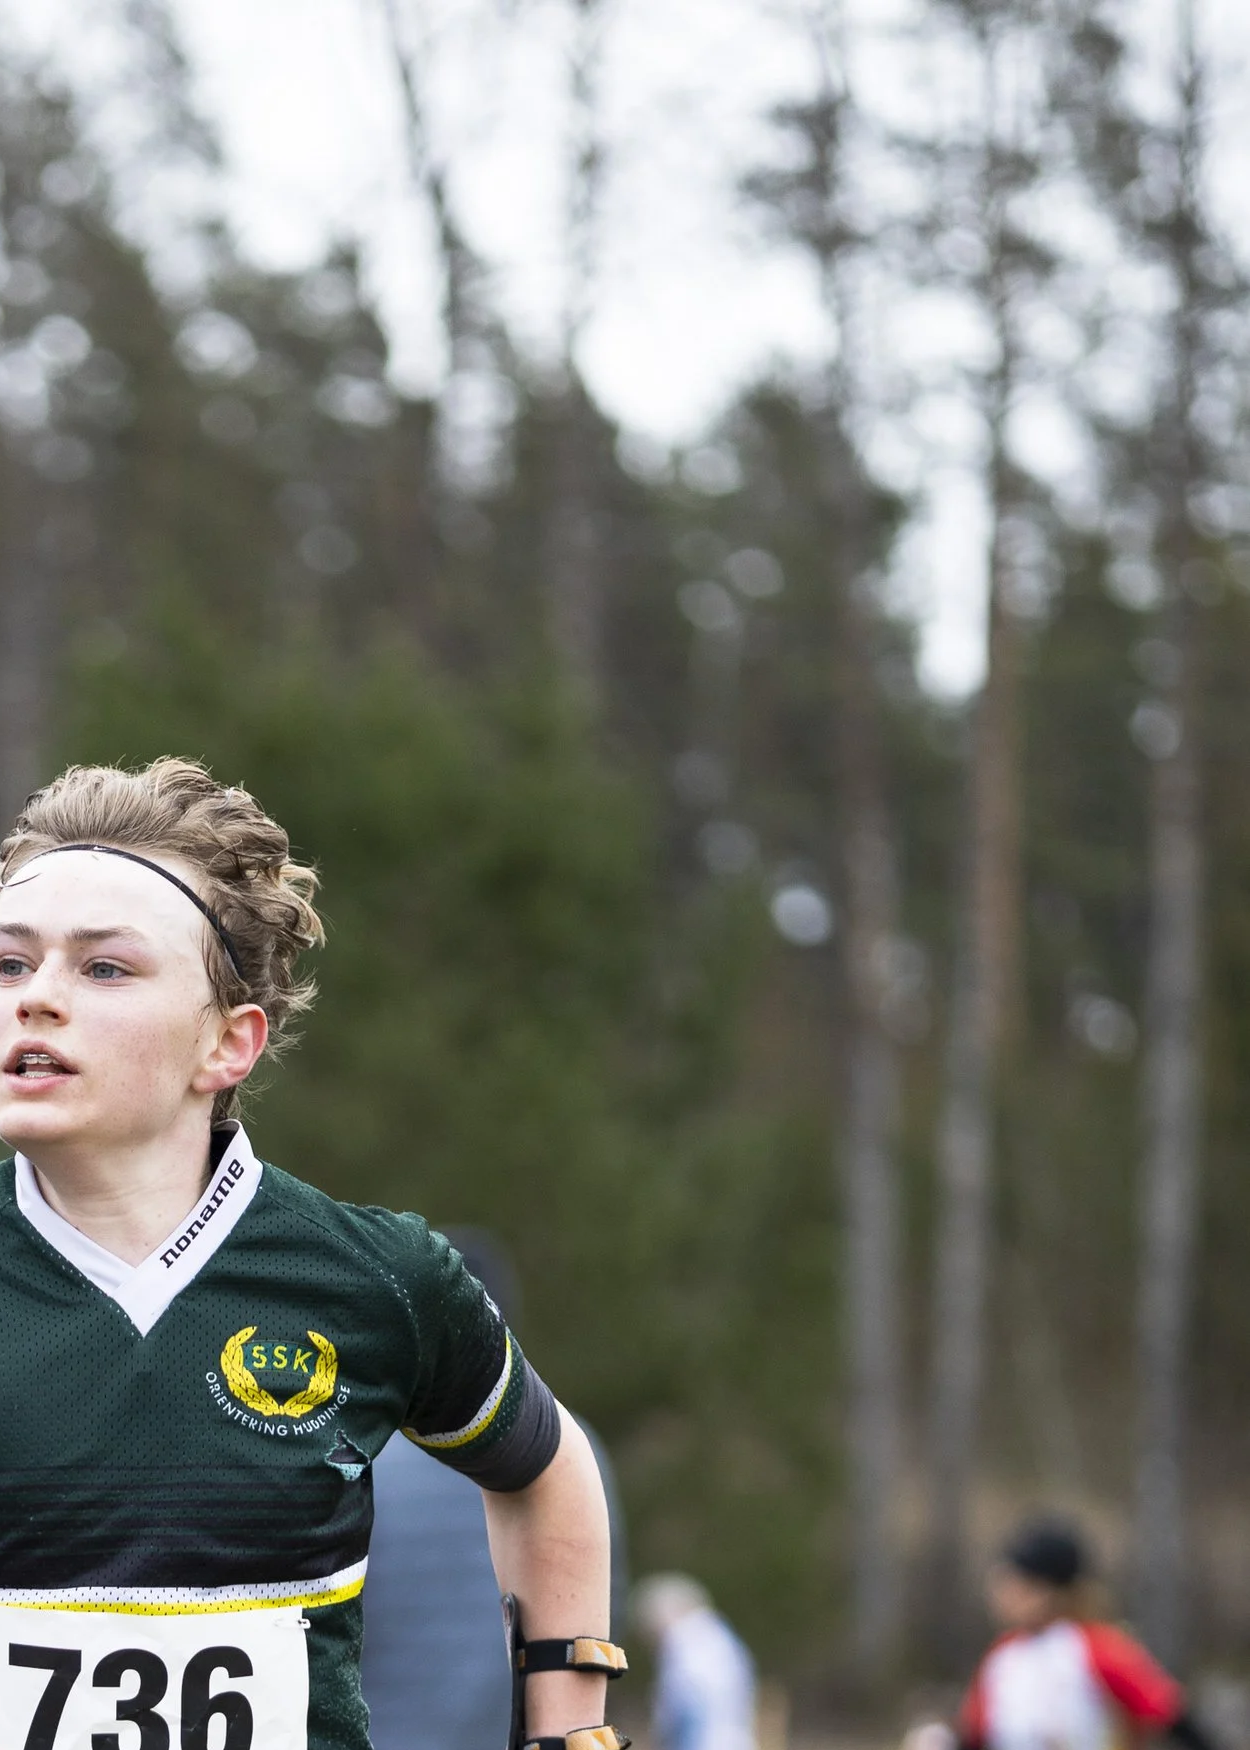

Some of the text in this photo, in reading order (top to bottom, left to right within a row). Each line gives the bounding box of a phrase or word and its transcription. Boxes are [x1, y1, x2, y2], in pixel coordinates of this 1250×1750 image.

[159, 1158, 246, 1269] noname
[250, 1345, 314, 1374] SSK
[205, 1371, 351, 1437] ORIENTERING HUDDINGE
